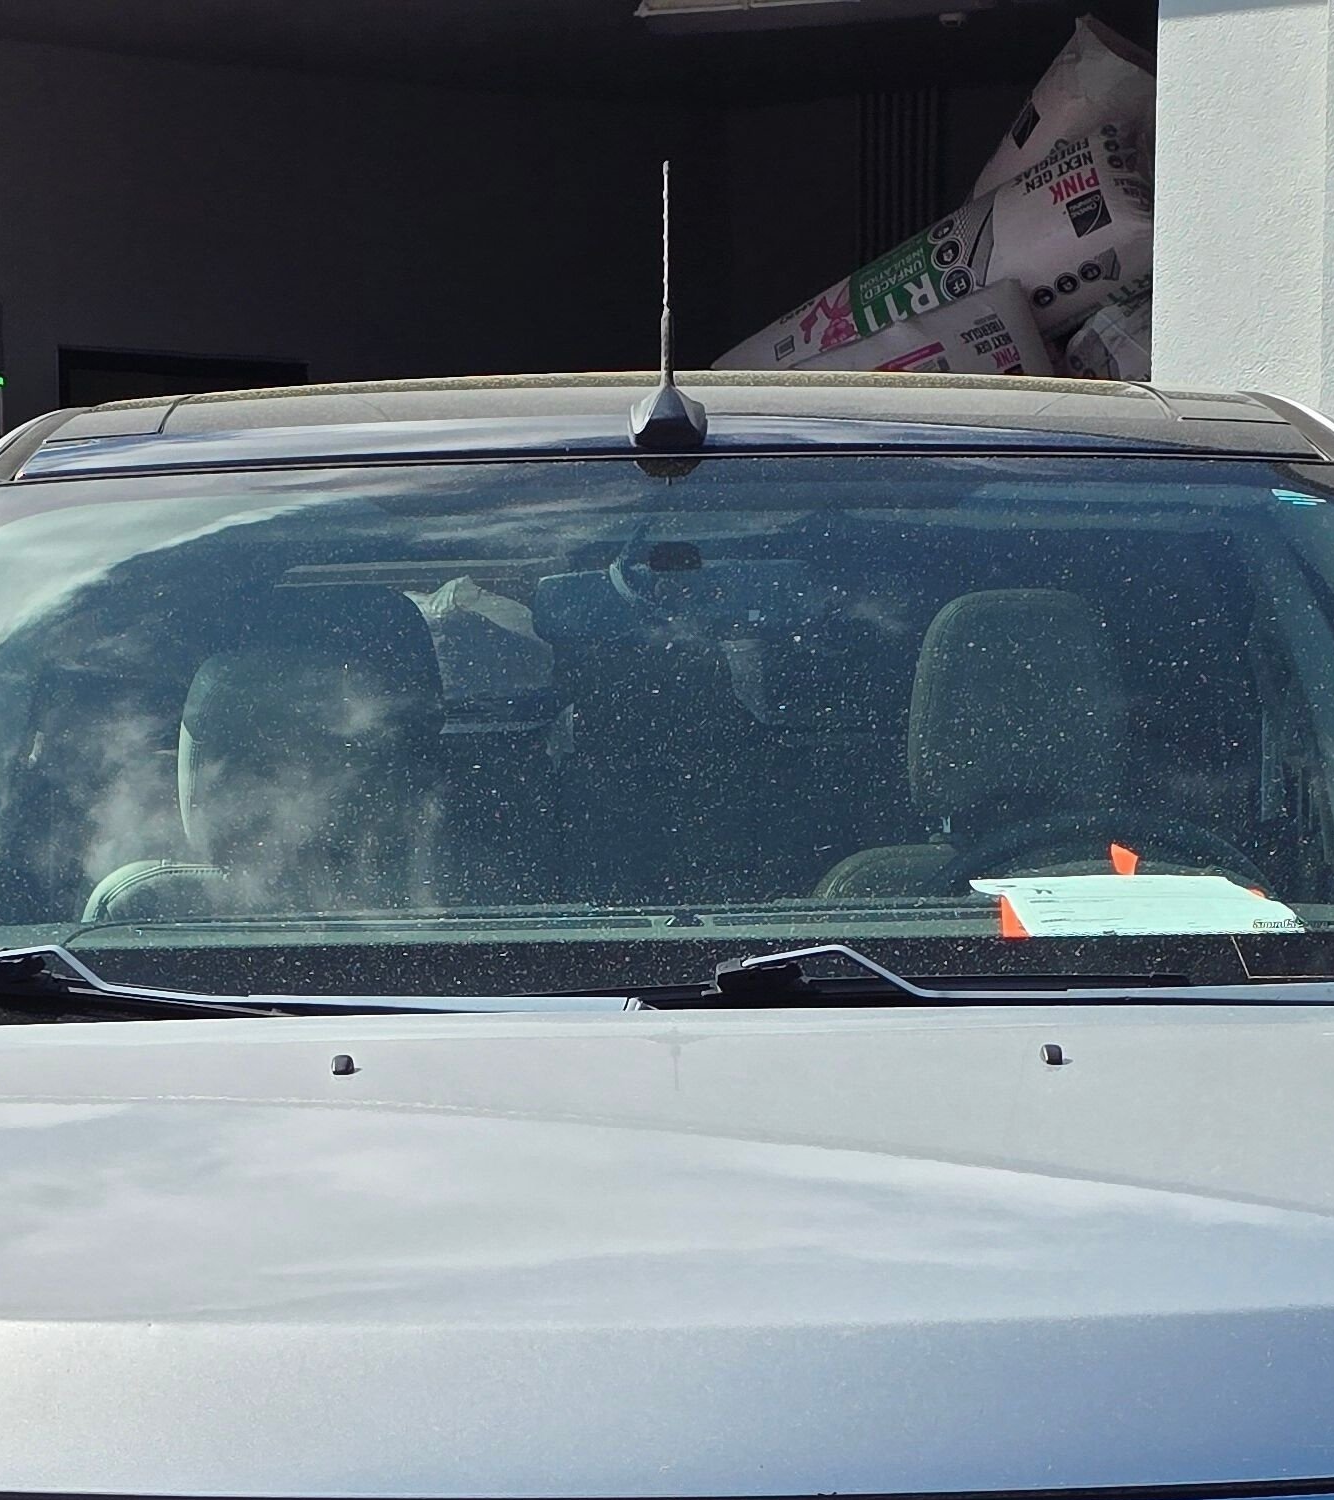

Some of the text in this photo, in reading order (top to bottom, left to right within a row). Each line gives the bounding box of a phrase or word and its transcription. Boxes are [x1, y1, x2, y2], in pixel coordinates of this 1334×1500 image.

[1024, 151, 1093, 195] NEXT GEN
[1049, 167, 1100, 206] PINK
[864, 259, 923, 301] UNFACED
[863, 272, 940, 333] R11
[991, 345, 1021, 369] PINK
